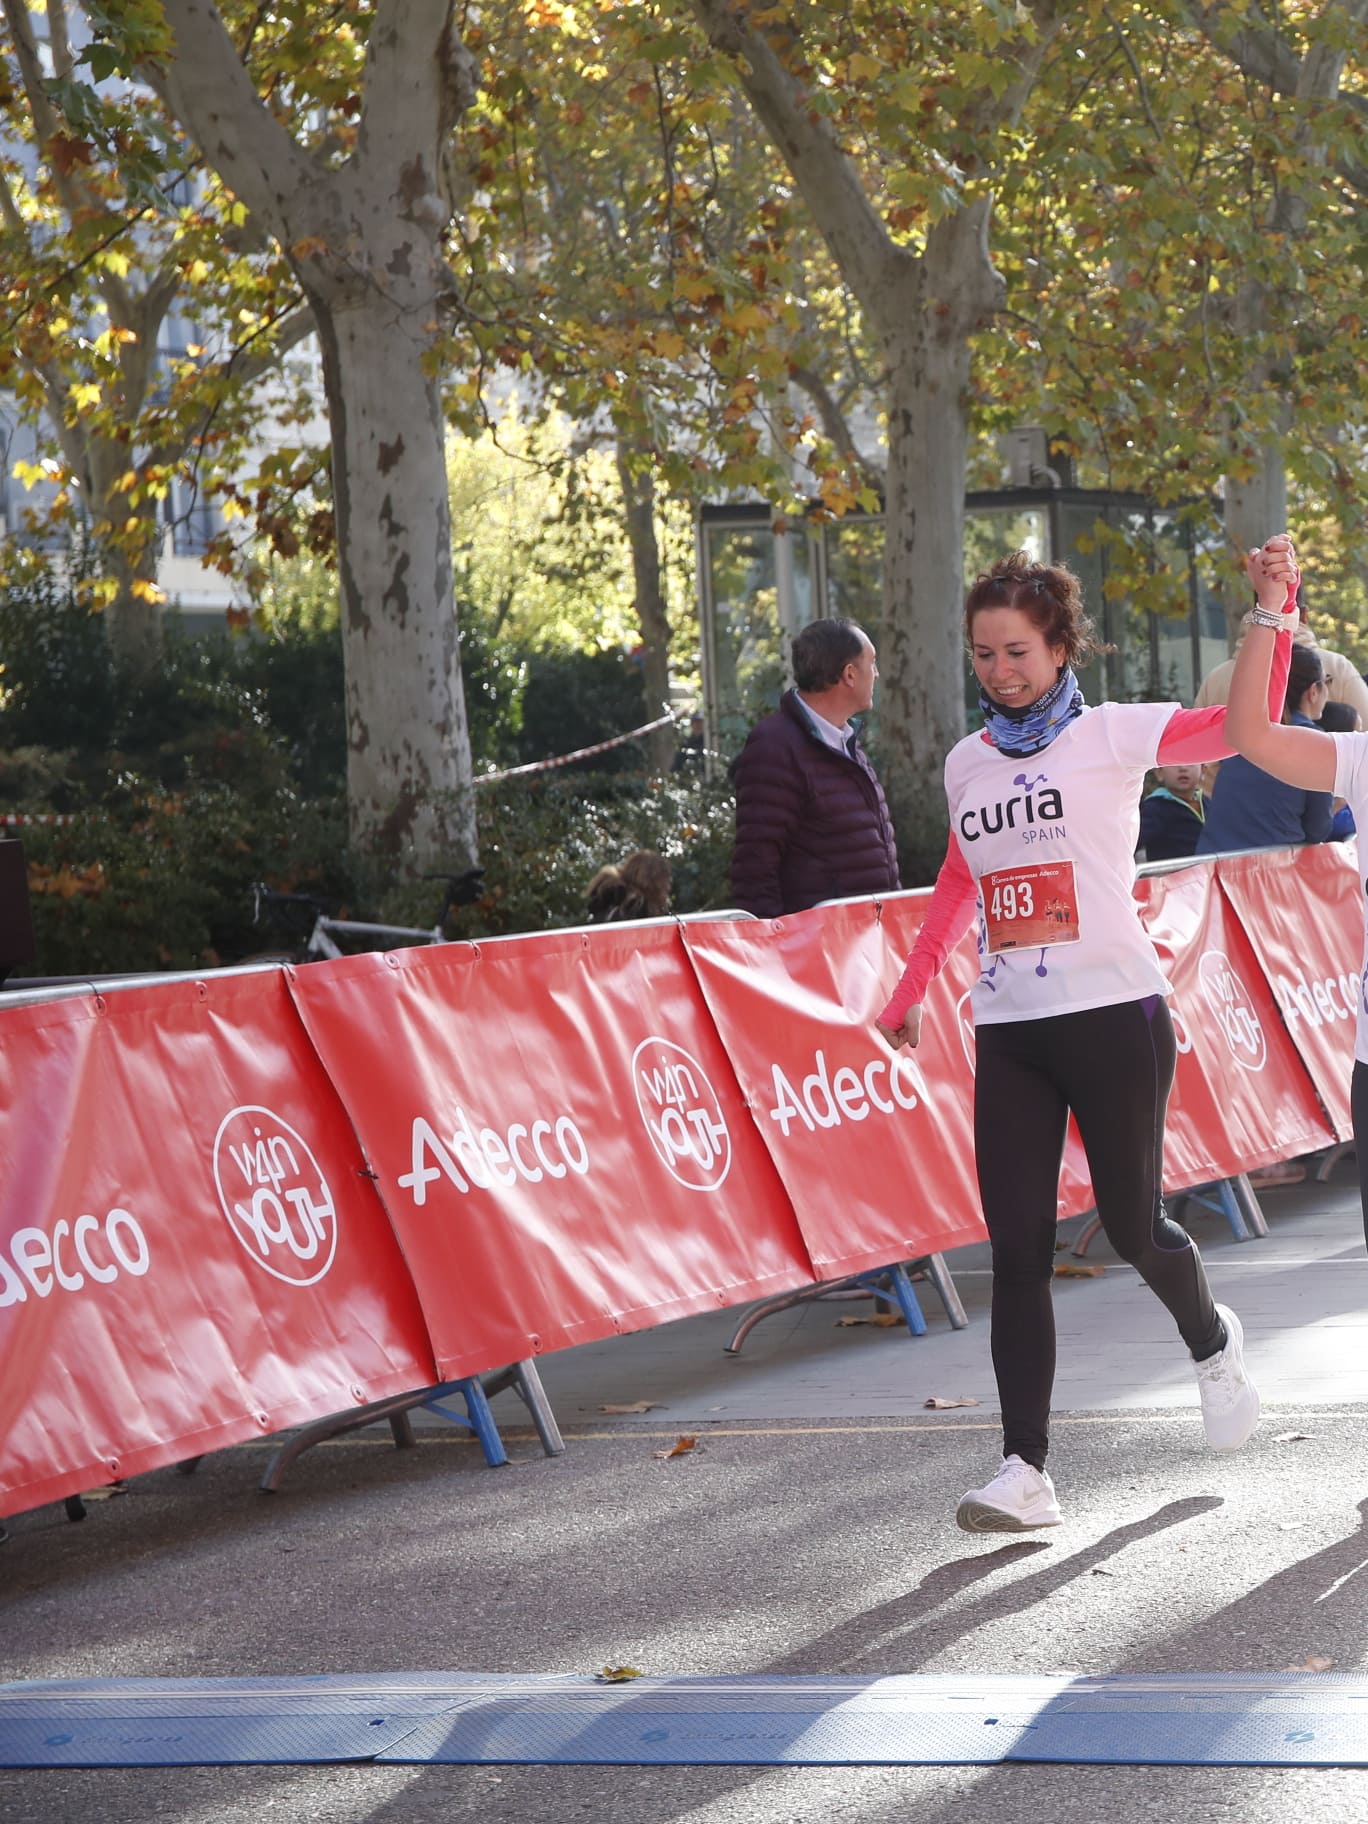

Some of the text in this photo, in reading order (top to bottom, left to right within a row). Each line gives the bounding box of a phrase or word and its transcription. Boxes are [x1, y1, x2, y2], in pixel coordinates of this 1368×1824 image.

[960, 788, 1064, 842] curia
[1022, 825, 1067, 845] SPAIN
[991, 882, 1035, 922] 493
[397, 1106, 589, 1206] Adecco
[0, 1208, 149, 1308] decco
